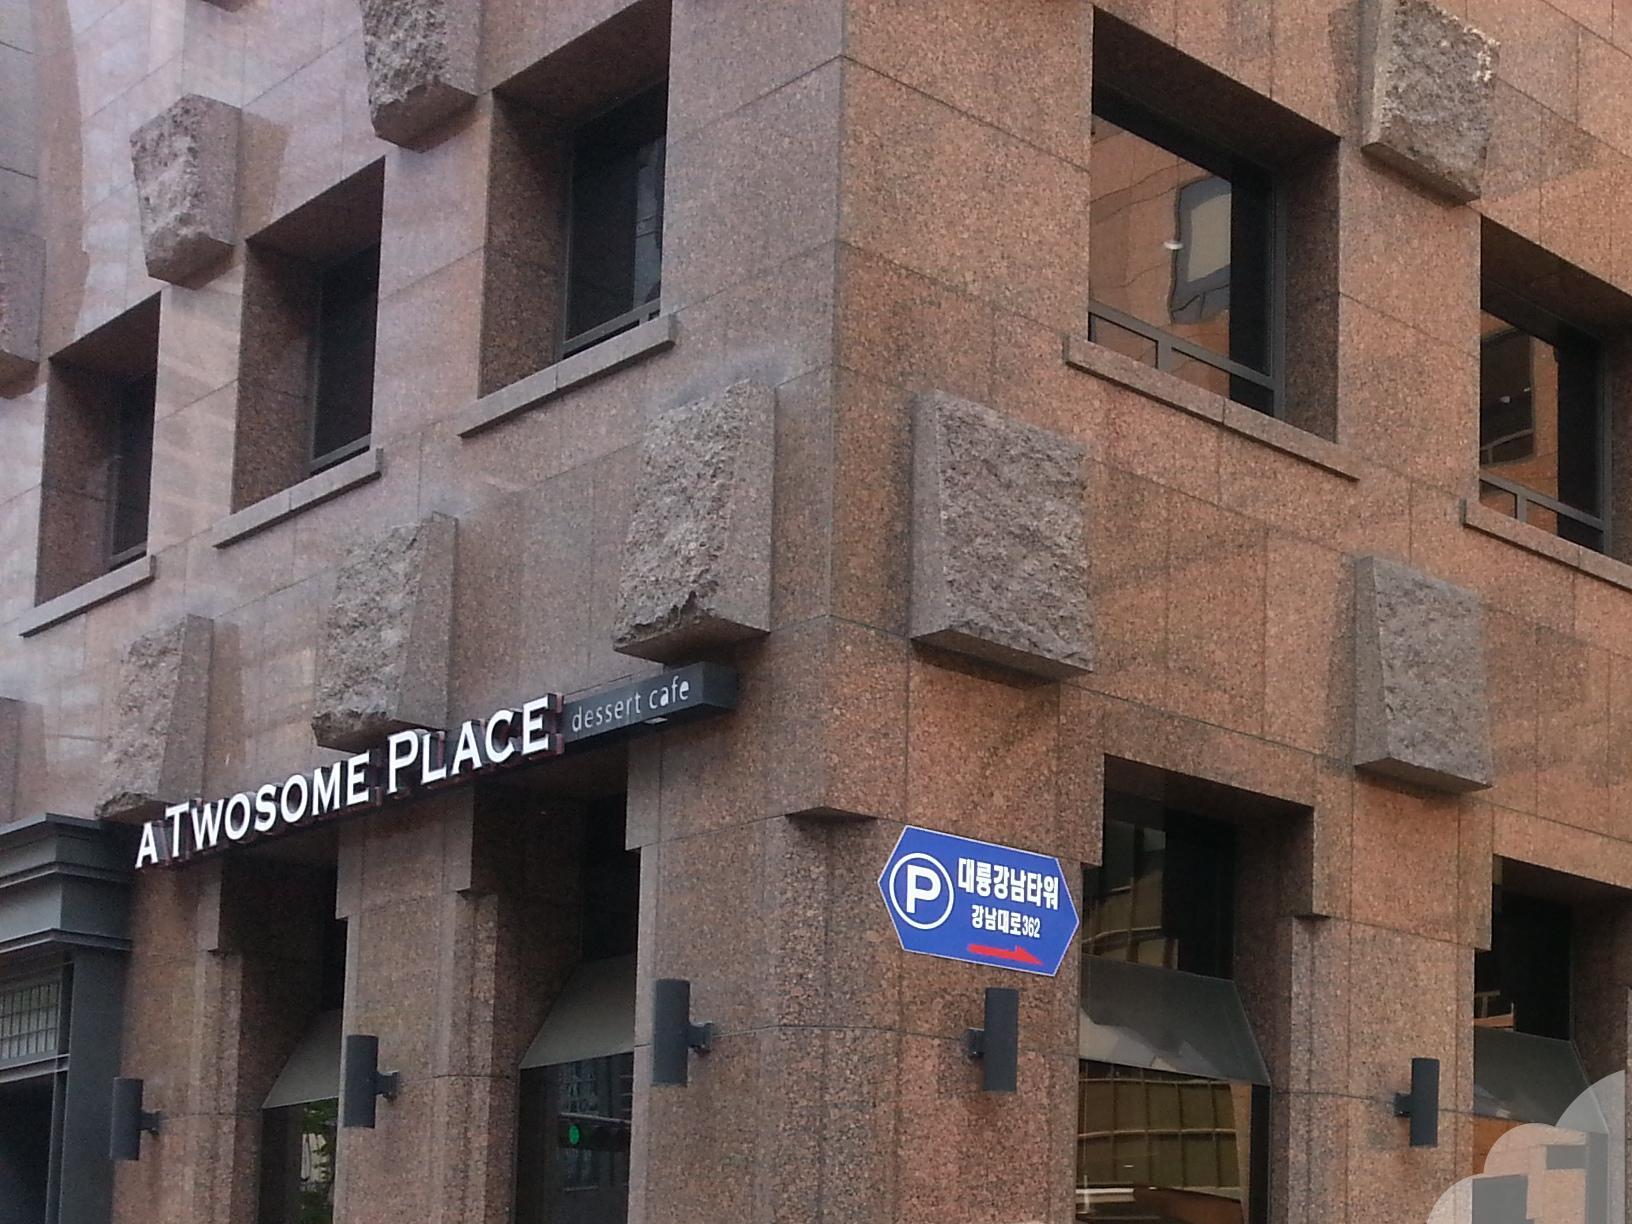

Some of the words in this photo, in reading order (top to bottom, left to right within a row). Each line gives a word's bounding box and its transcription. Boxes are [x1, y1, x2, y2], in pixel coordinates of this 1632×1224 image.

[572, 692, 641, 733] dessert
[649, 675, 690, 710] cafe
[134, 820, 159, 869] A
[164, 750, 370, 858] TWOSOME
[386, 695, 549, 794] PLACE
[906, 864, 942, 914] P
[957, 857, 1060, 910] 대륭강남타워
[971, 904, 1041, 938] 강남대로362
